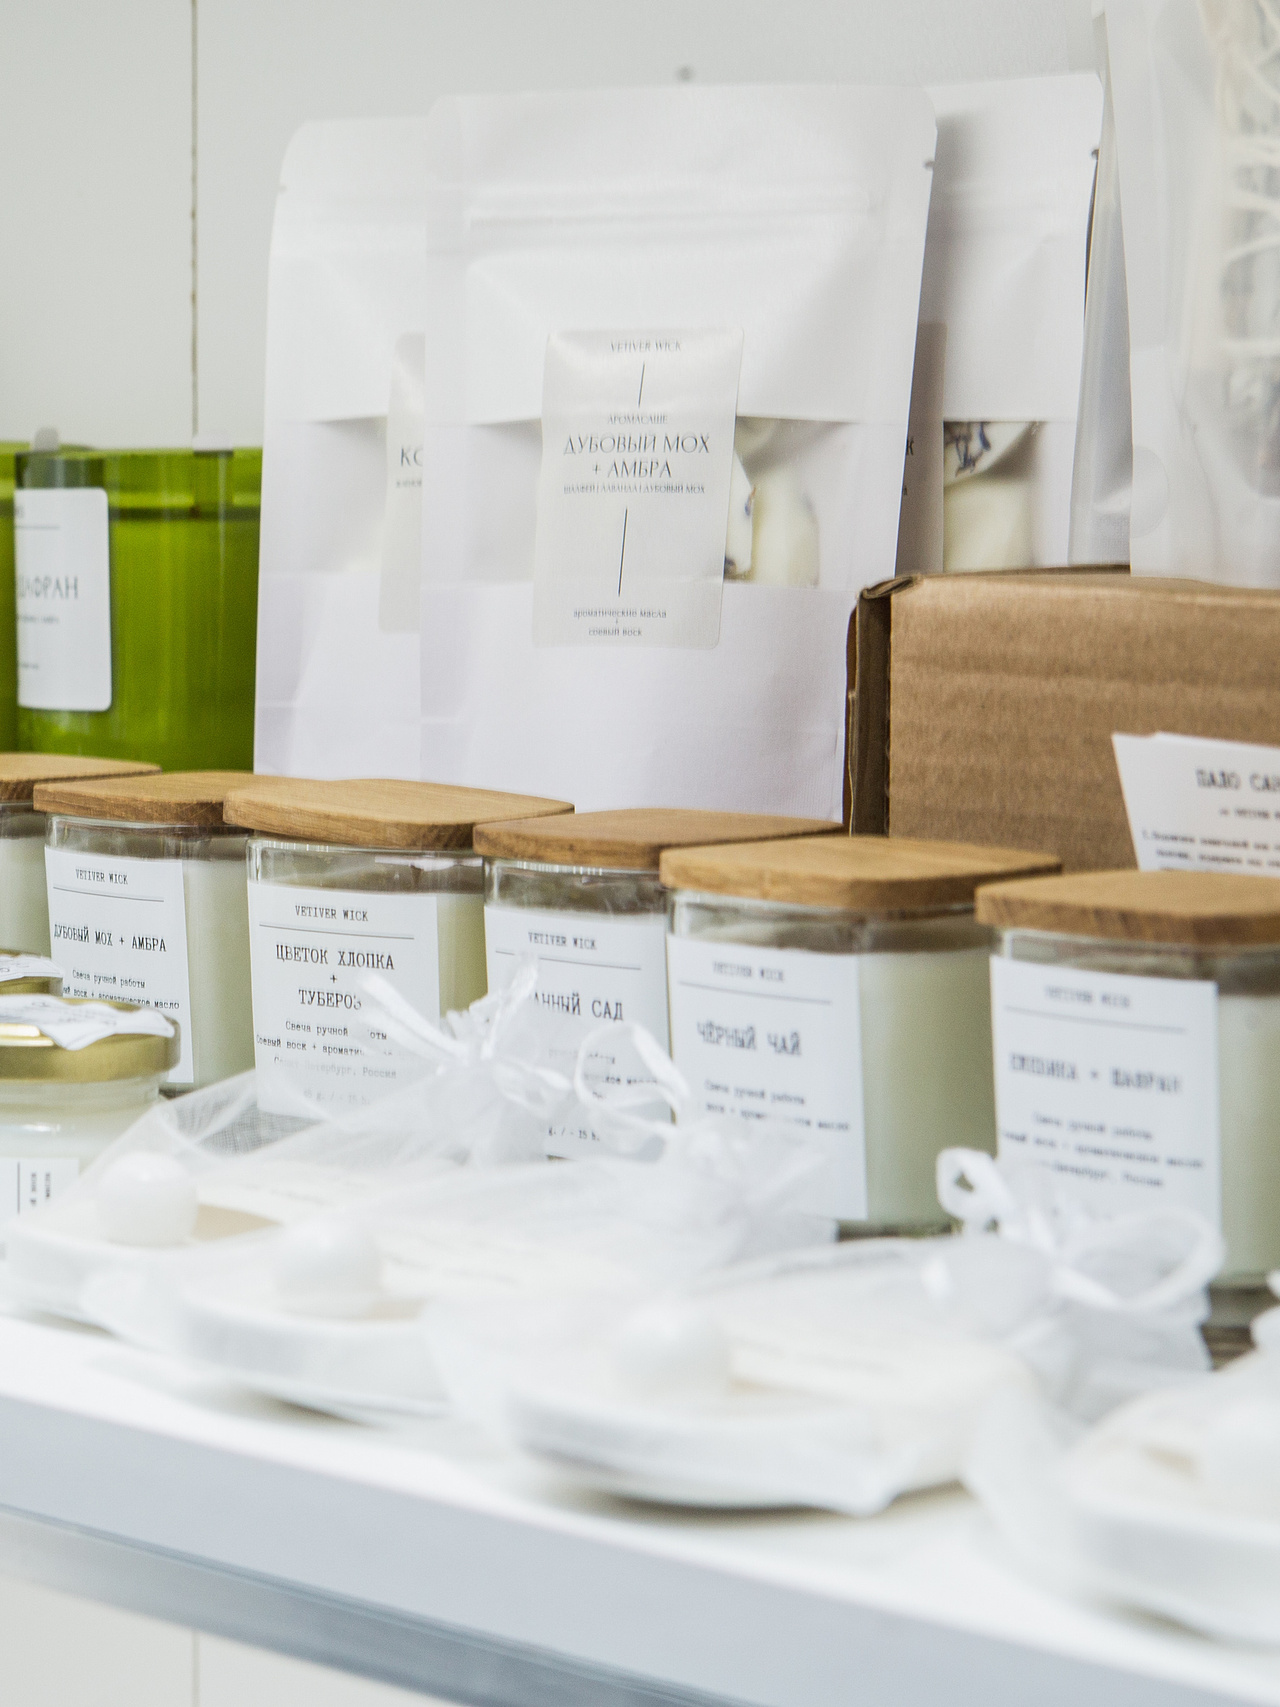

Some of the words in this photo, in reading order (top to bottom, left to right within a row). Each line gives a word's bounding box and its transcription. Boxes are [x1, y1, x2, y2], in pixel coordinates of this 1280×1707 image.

[610, 339, 651, 352] VETIVER
[655, 339, 682, 352] WICK
[563, 433, 657, 456] ДУБОВЫЙ
[663, 434, 710, 454] МОХ
[608, 460, 672, 478] АМБРА
[573, 608, 637, 619] ароматические
[639, 609, 667, 618] масла
[622, 627, 642, 637] воск
[75, 869, 105, 883] VETIVER
[109, 873, 129, 885] WICK
[295, 905, 337, 920] VETIVER
[342, 909, 369, 922] WICK
[53, 923, 90, 944] ДУБОВЫЙ
[95, 930, 113, 947] МОХ
[131, 935, 167, 953] АМБРА
[528, 932, 567, 947] VETIVER
[573, 937, 597, 950] WICK
[276, 944, 329, 966] ЦВЕТОК
[337, 950, 395, 970] ХЛОПКА
[72, 969, 91, 981] Свеча
[94, 974, 117, 986] ручной
[120, 977, 146, 990] работы
[329, 974, 337, 984] +
[73, 988, 88, 998] воск
[154, 1000, 180, 1010] масло
[298, 988, 362, 1011] ТУБЕРОЗ
[591, 999, 624, 1022] САД
[285, 1020, 311, 1033] Свеча
[316, 1025, 349, 1037] ручной
[369, 1031, 387, 1040] оты
[697, 1019, 756, 1051] ЧЁРНЫЙ
[767, 1030, 801, 1057] ЧАЙ
[256, 1034, 282, 1048] Соевый
[286, 1040, 307, 1051] воск
